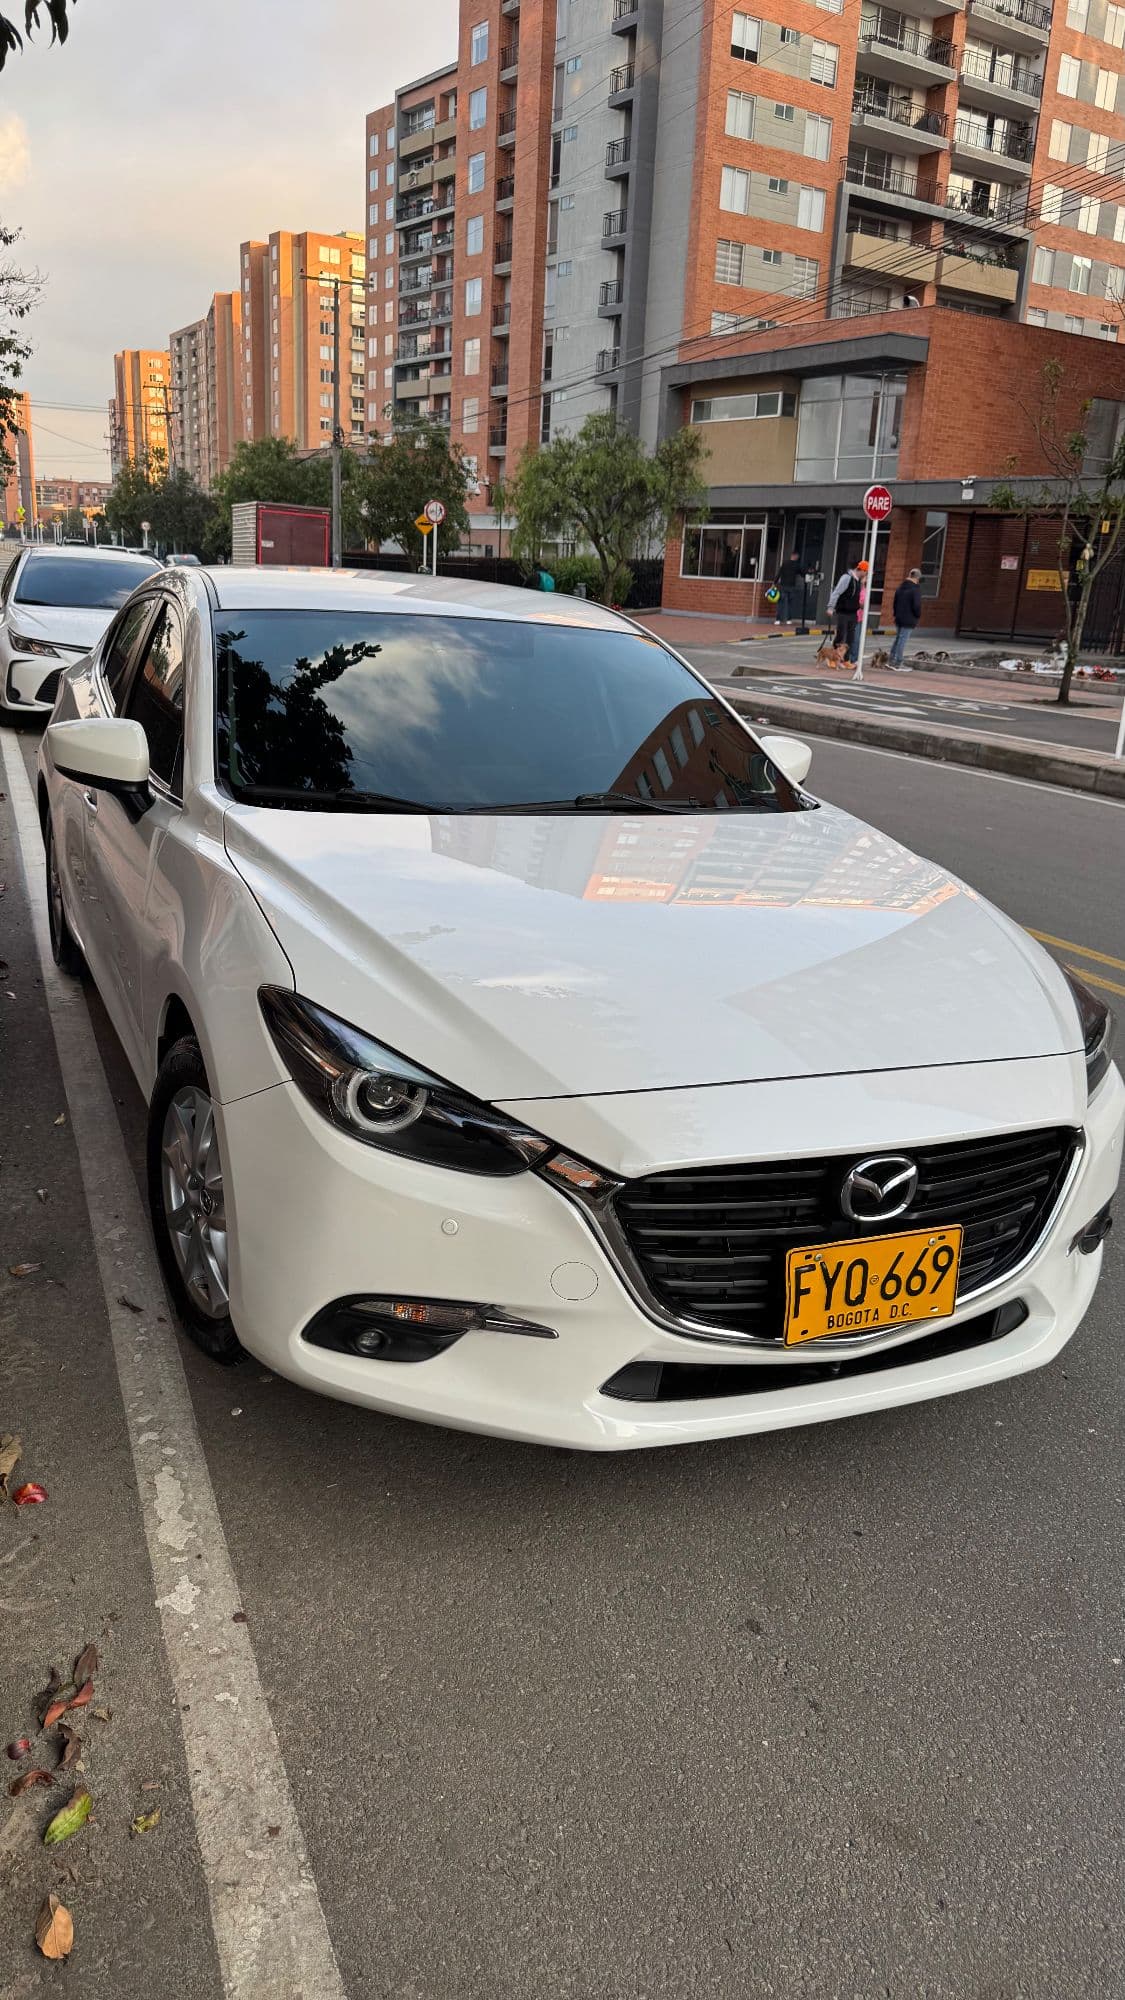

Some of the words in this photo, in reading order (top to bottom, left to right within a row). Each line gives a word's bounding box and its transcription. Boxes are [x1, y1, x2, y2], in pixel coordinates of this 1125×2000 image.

[867, 496, 890, 511] PARE
[793, 1258, 869, 1319] FYQ
[880, 1244, 955, 1301] 669
[827, 1307, 879, 1329] BOGOTA
[889, 1303, 913, 1319] D.C.
